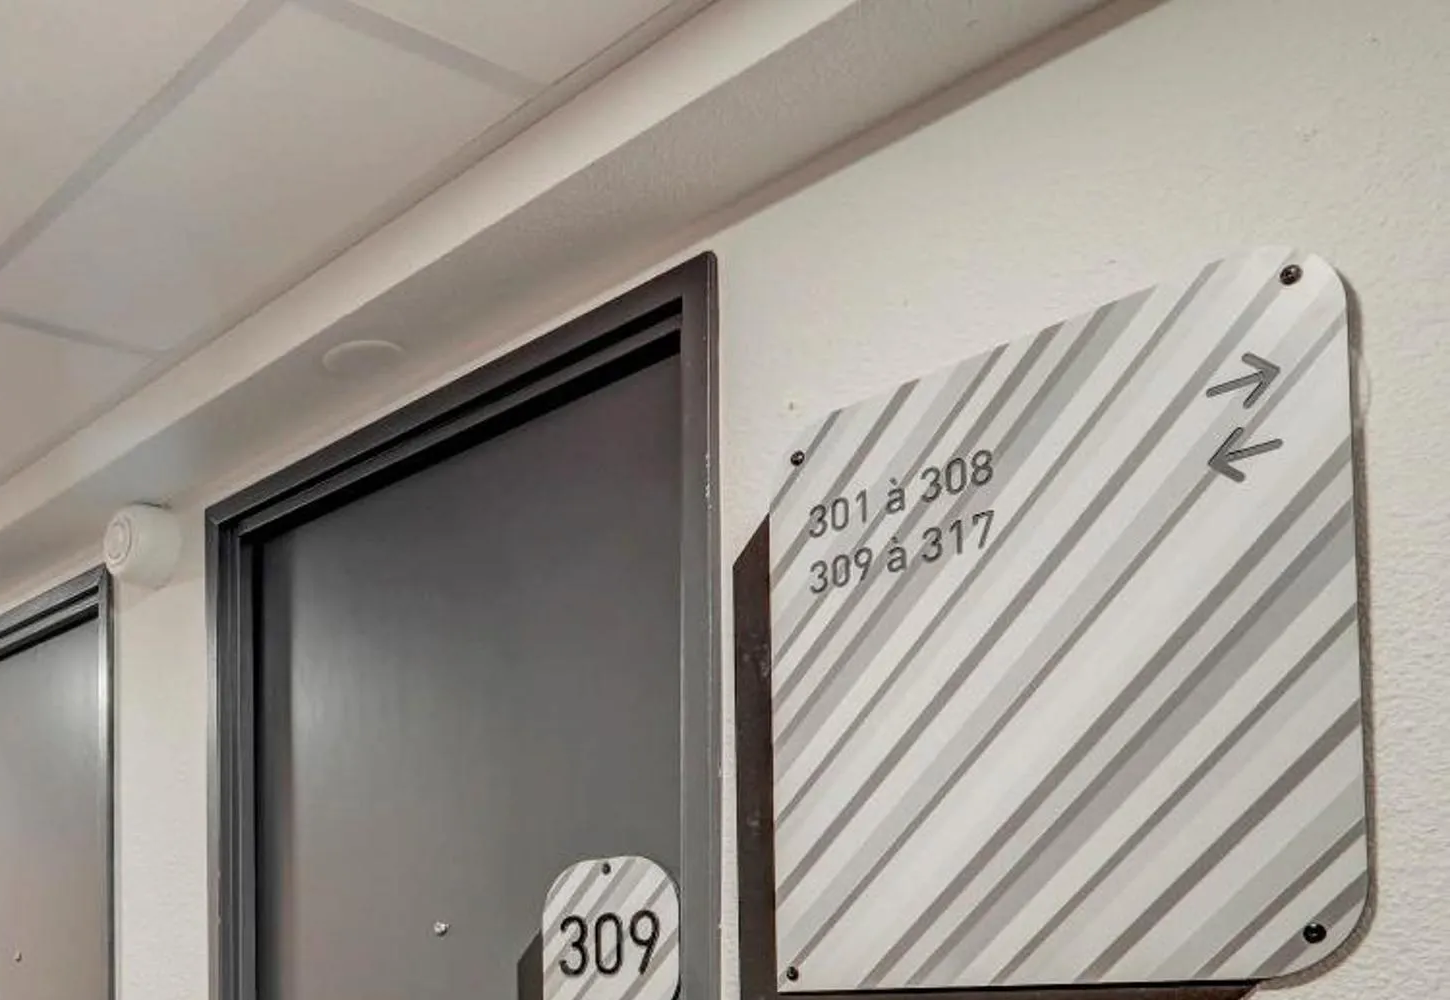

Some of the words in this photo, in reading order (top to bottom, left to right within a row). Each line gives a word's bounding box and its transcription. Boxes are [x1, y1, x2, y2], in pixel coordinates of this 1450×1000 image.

[807, 489, 869, 539] 301
[884, 478, 907, 515] à
[919, 449, 994, 504] 308
[809, 547, 873, 595] 309
[885, 536, 908, 573] à
[920, 510, 995, 564] 317
[559, 909, 660, 976] 309
